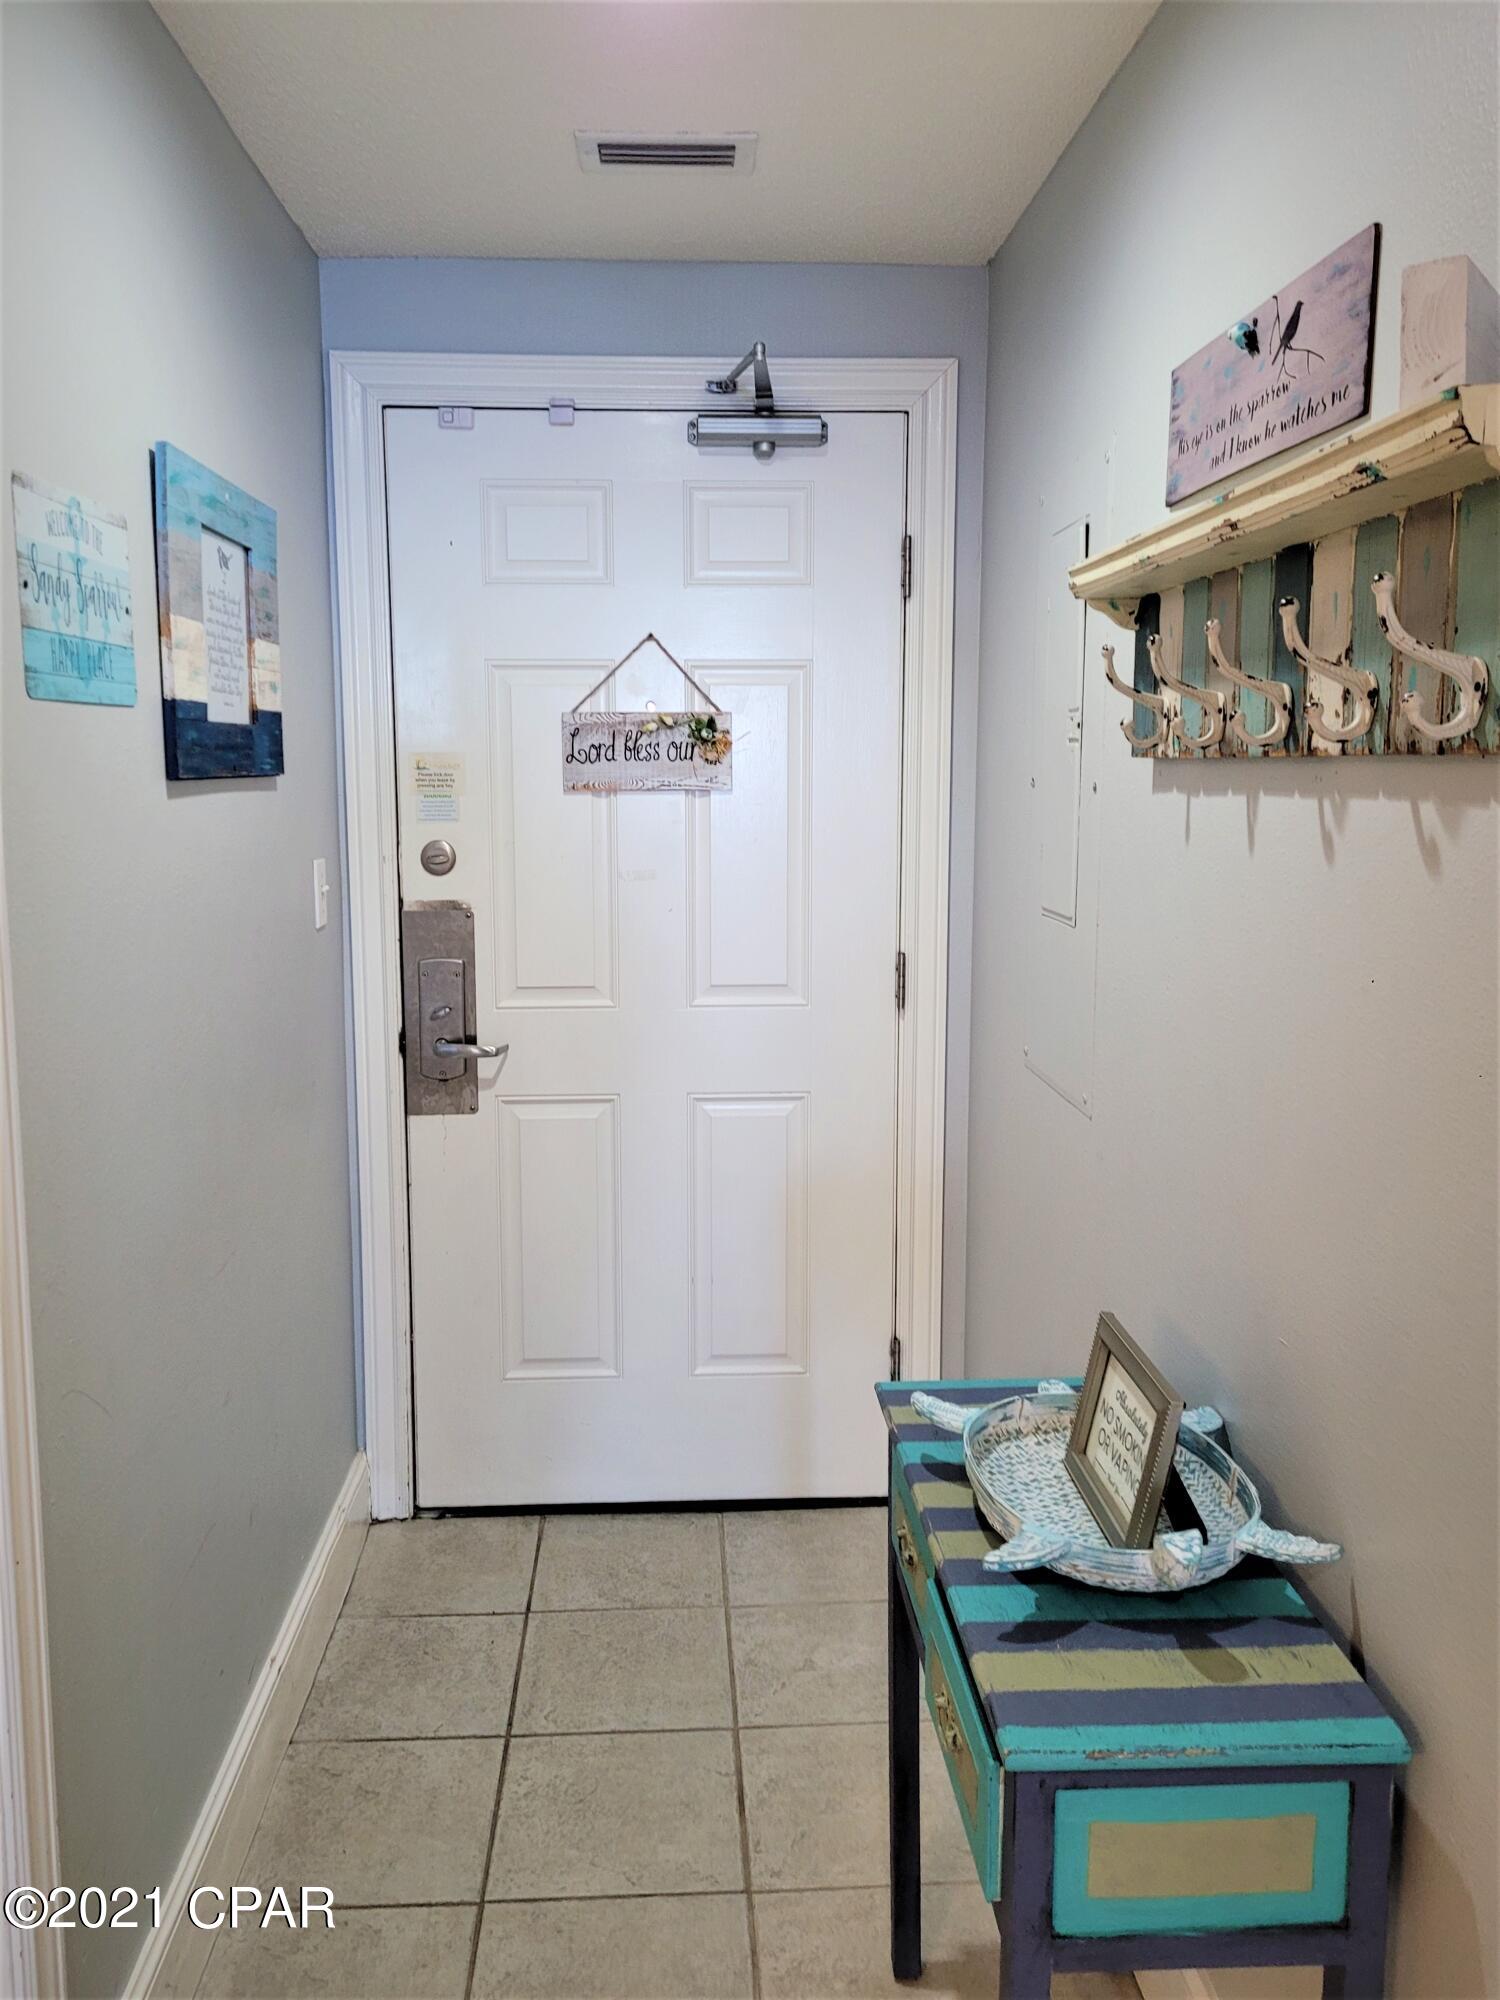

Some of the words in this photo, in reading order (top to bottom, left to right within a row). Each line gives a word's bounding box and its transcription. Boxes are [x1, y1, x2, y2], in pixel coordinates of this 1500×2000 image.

[1177, 437, 1190, 458] His
[1191, 430, 1204, 456] eye
[1205, 423, 1214, 441] is
[1215, 418, 1227, 434] on
[1229, 403, 1243, 427] the
[1246, 380, 1291, 422] sparrow
[1210, 447, 1226, 470] and
[1229, 437, 1235, 460] I
[1235, 430, 1262, 454] know
[1280, 396, 1328, 433] watches
[1331, 383, 1351, 408] me
[49, 636, 81, 676] HAPPY
[565, 727, 618, 764] Lord
[623, 729, 660, 762] bless
[666, 741, 698, 762] our
[1098, 1427, 1111, 1455] OR
[1100, 1397, 1114, 1425] NO
[1113, 1415, 1143, 1472] SMOKIN
